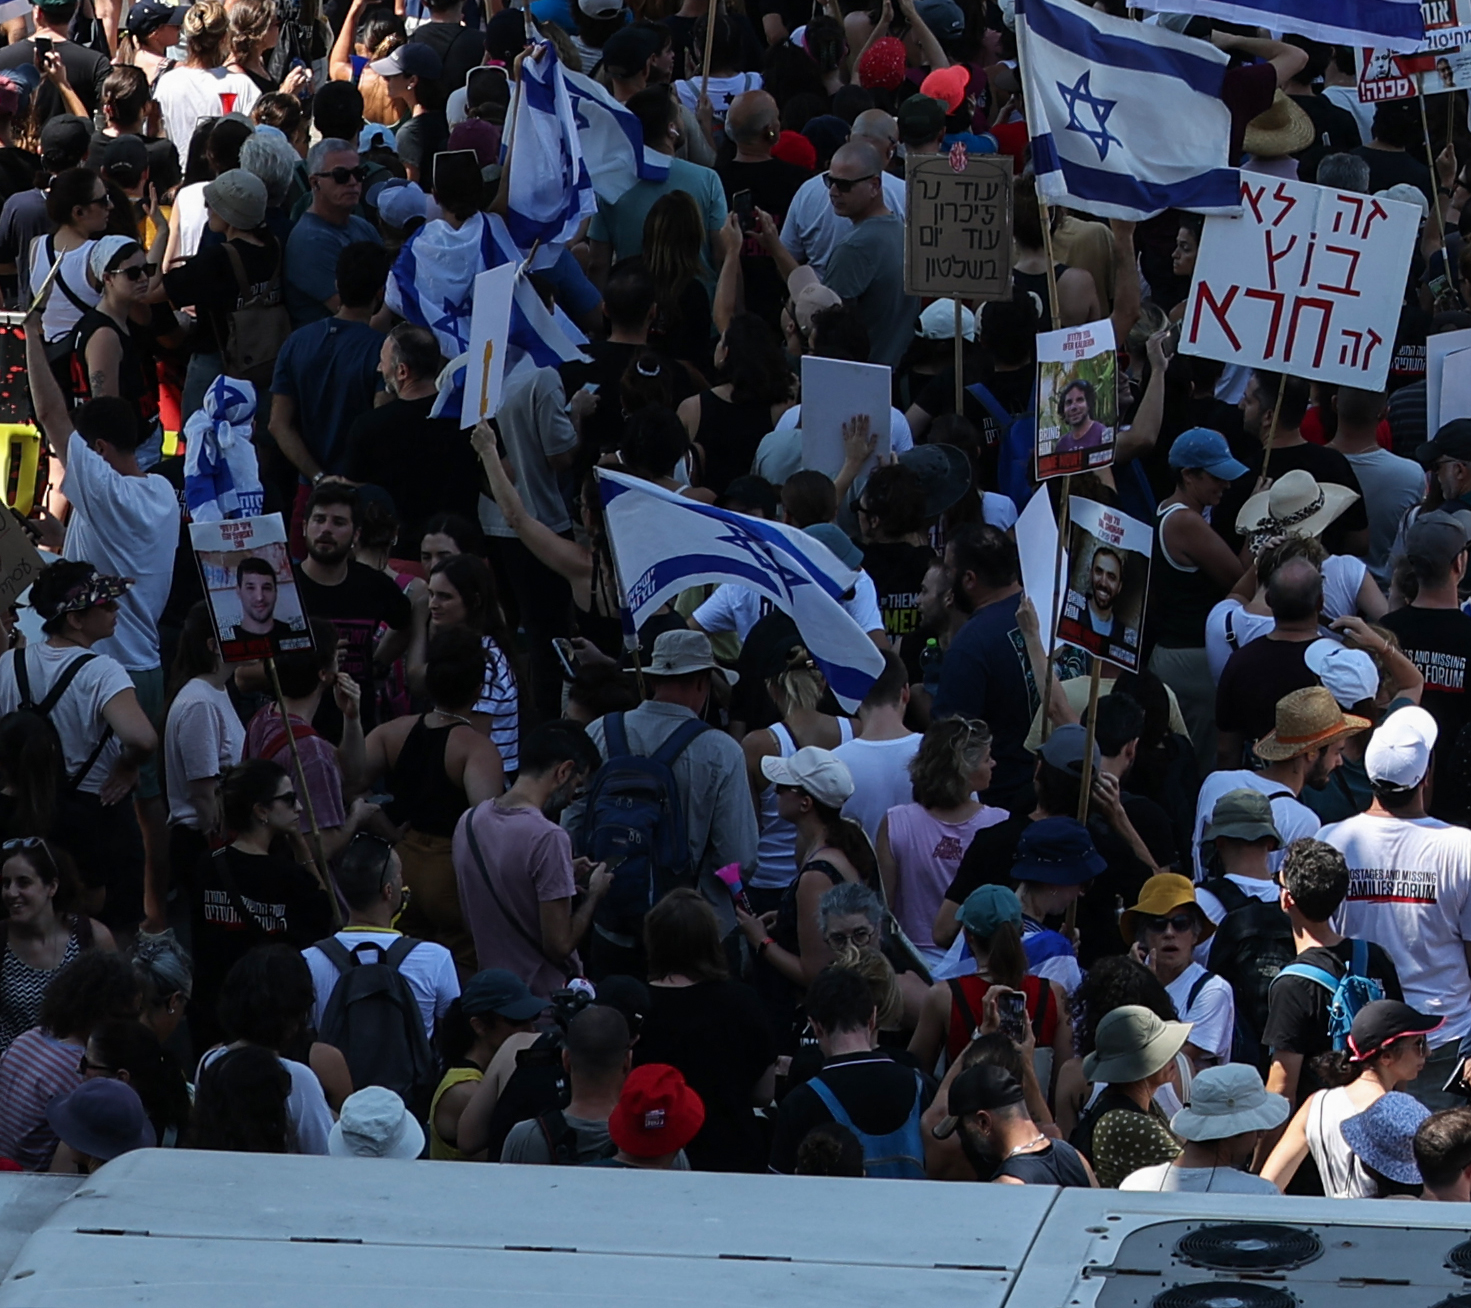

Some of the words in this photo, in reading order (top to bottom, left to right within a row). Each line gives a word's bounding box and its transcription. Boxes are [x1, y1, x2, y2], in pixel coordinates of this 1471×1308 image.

[1360, 75, 1410, 103] סכנה!
[915, 179, 941, 202] נר
[955, 180, 1000, 201] עוד
[1239, 180, 1298, 228] לא
[1332, 192, 1389, 240] זה
[968, 227, 1000, 252] עוד
[923, 253, 998, 285] בשלטון
[1187, 280, 1336, 370] חרא
[1337, 326, 1383, 372] זה
[1038, 426, 1061, 441] BRING
[1413, 650, 1430, 665] AND
[1430, 652, 1466, 670] MISSING
[1425, 668, 1464, 689] FORUM
[1349, 867, 1385, 883] OSTAGES
[1385, 868, 1401, 883] AND
[1401, 869, 1437, 886] MISSING
[1395, 882, 1436, 899] FORUM
